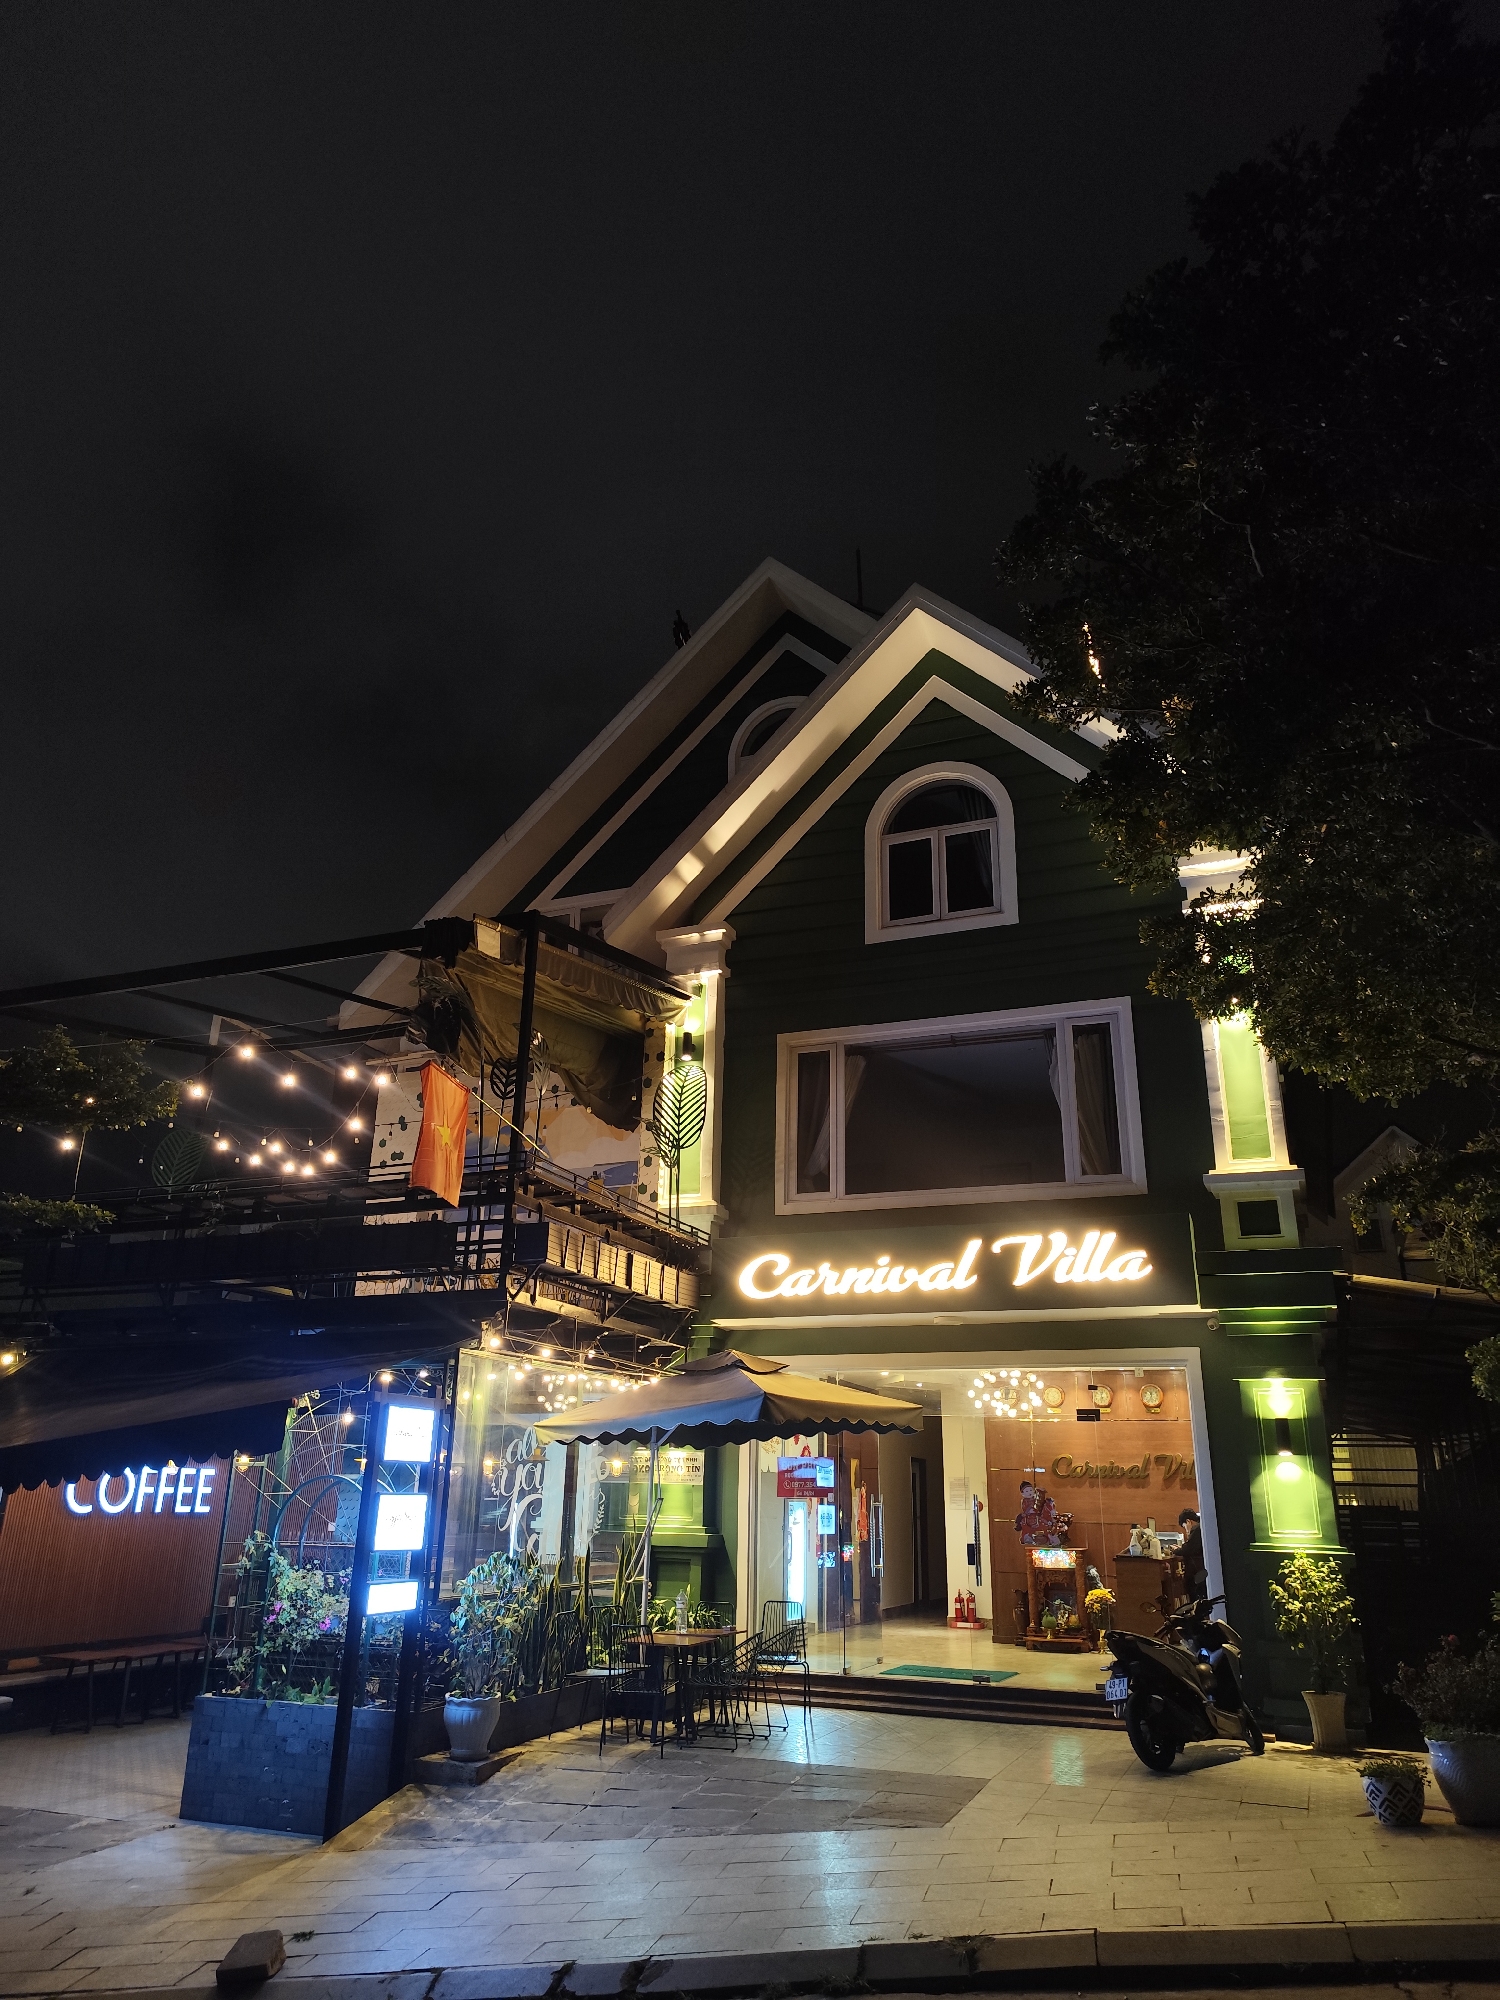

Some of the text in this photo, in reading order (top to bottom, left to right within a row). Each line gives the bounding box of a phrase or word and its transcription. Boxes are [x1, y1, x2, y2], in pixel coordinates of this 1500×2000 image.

[738, 1230, 1153, 1300] Carnival Villa
[66, 1466, 216, 1514] COFFEE
[1051, 1453, 1196, 1480] Carnival Vil
